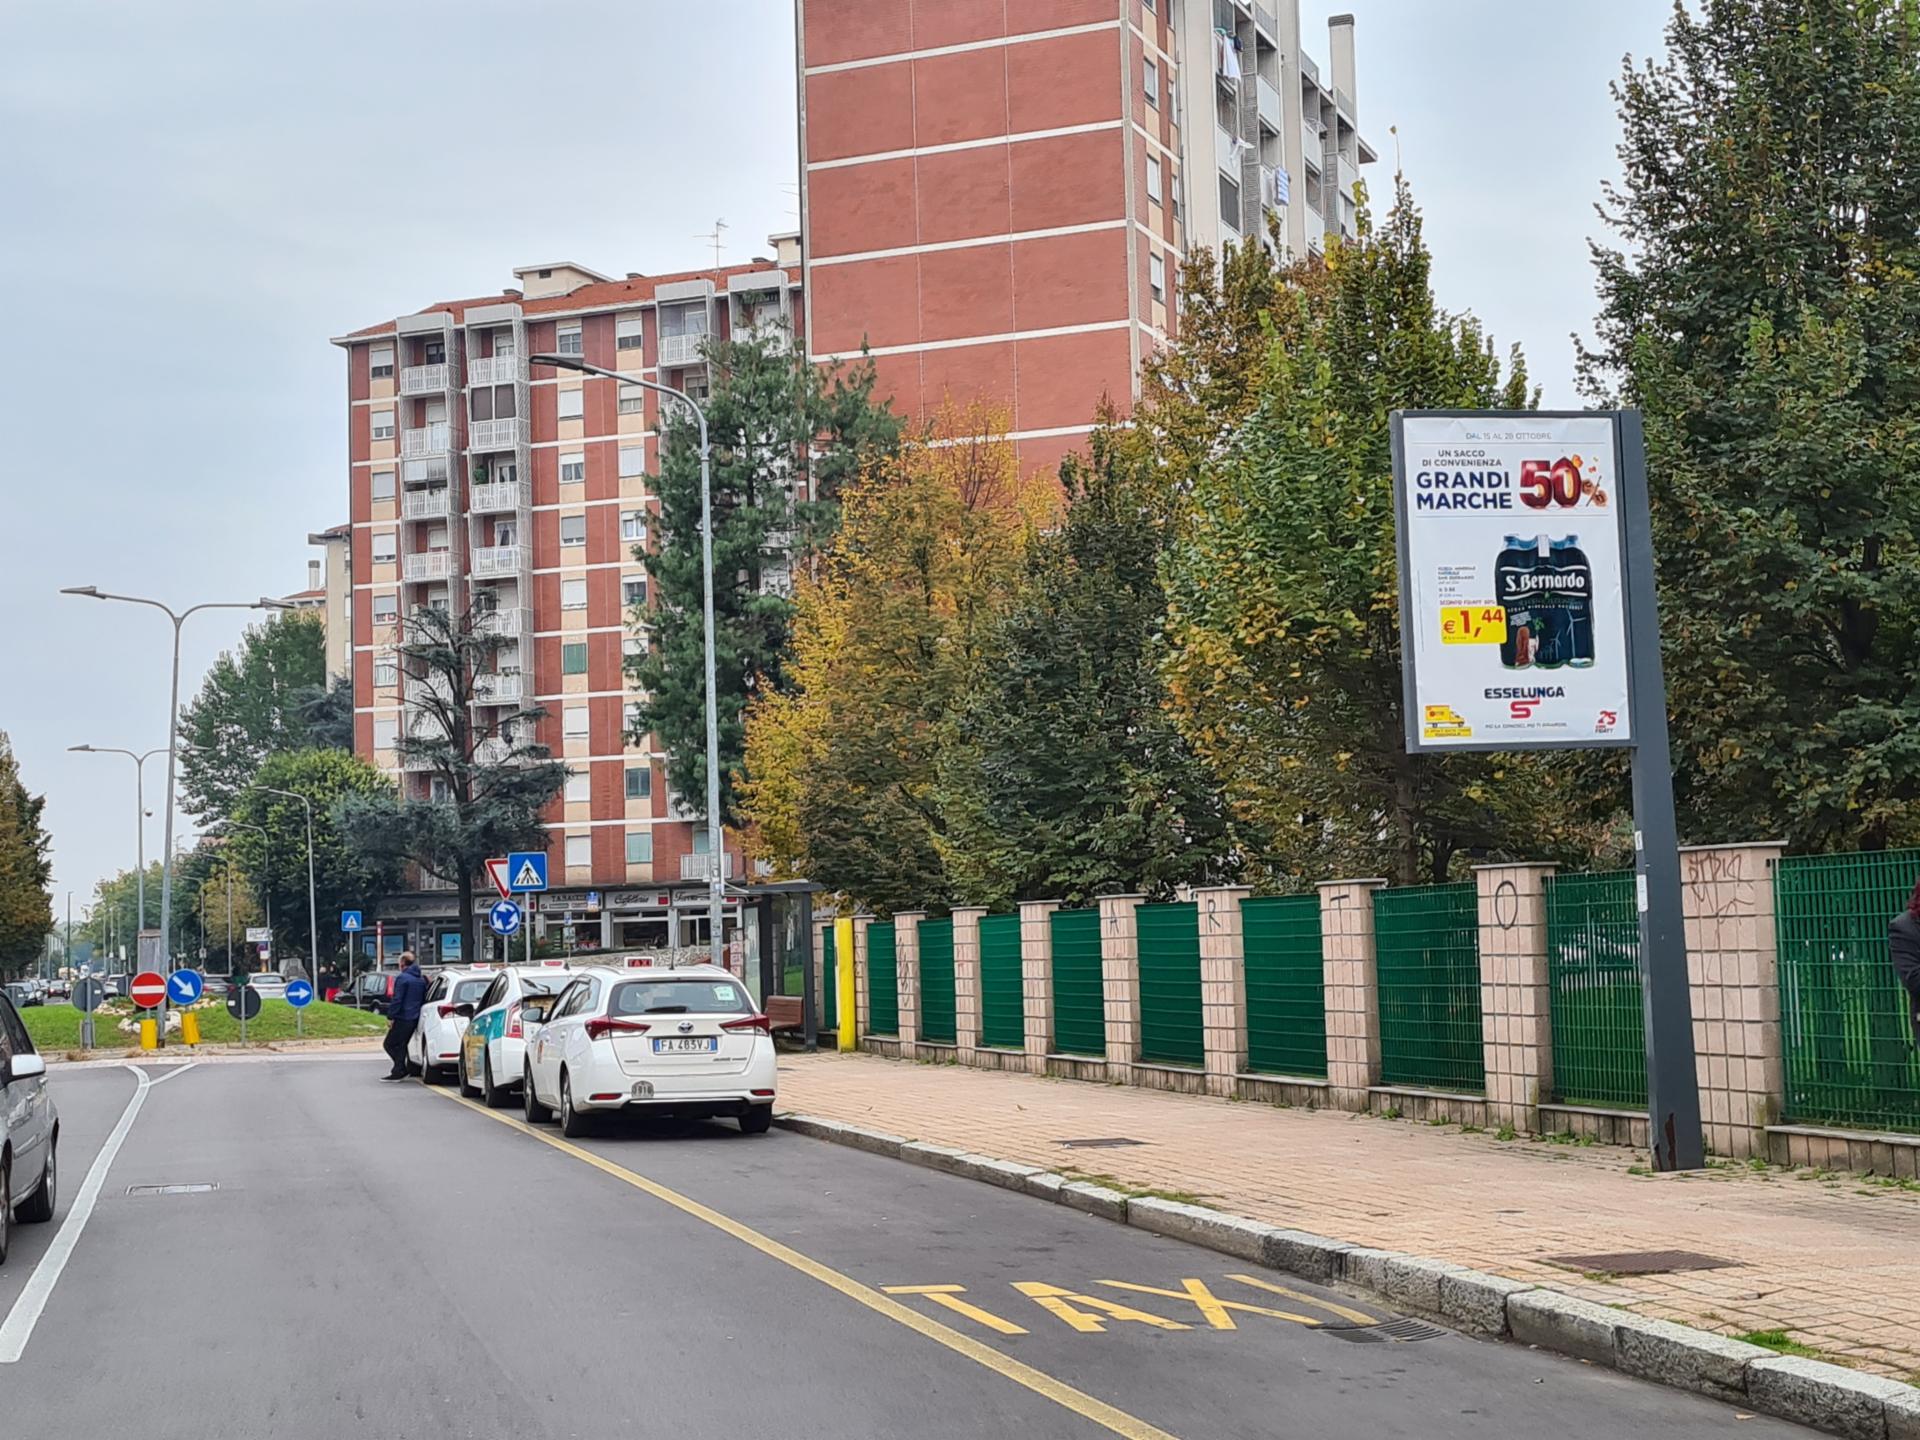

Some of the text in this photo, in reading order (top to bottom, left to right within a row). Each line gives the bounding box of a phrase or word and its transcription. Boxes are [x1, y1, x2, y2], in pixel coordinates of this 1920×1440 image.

[1466, 432, 1481, 440] DAL
[1492, 432, 1502, 440] AL
[1516, 432, 1552, 440] OTTOBRE
[1416, 471, 1509, 489] GRANDI
[1416, 492, 1512, 510] MARCHE
[1443, 620, 1455, 634] €
[1484, 686, 1565, 699] ESSELUNGA
[1597, 710, 1617, 725] 25
[628, 959, 652, 967] TAXI
[662, 1039, 673, 1050] FA
[879, 1274, 1380, 1334] TAXI
